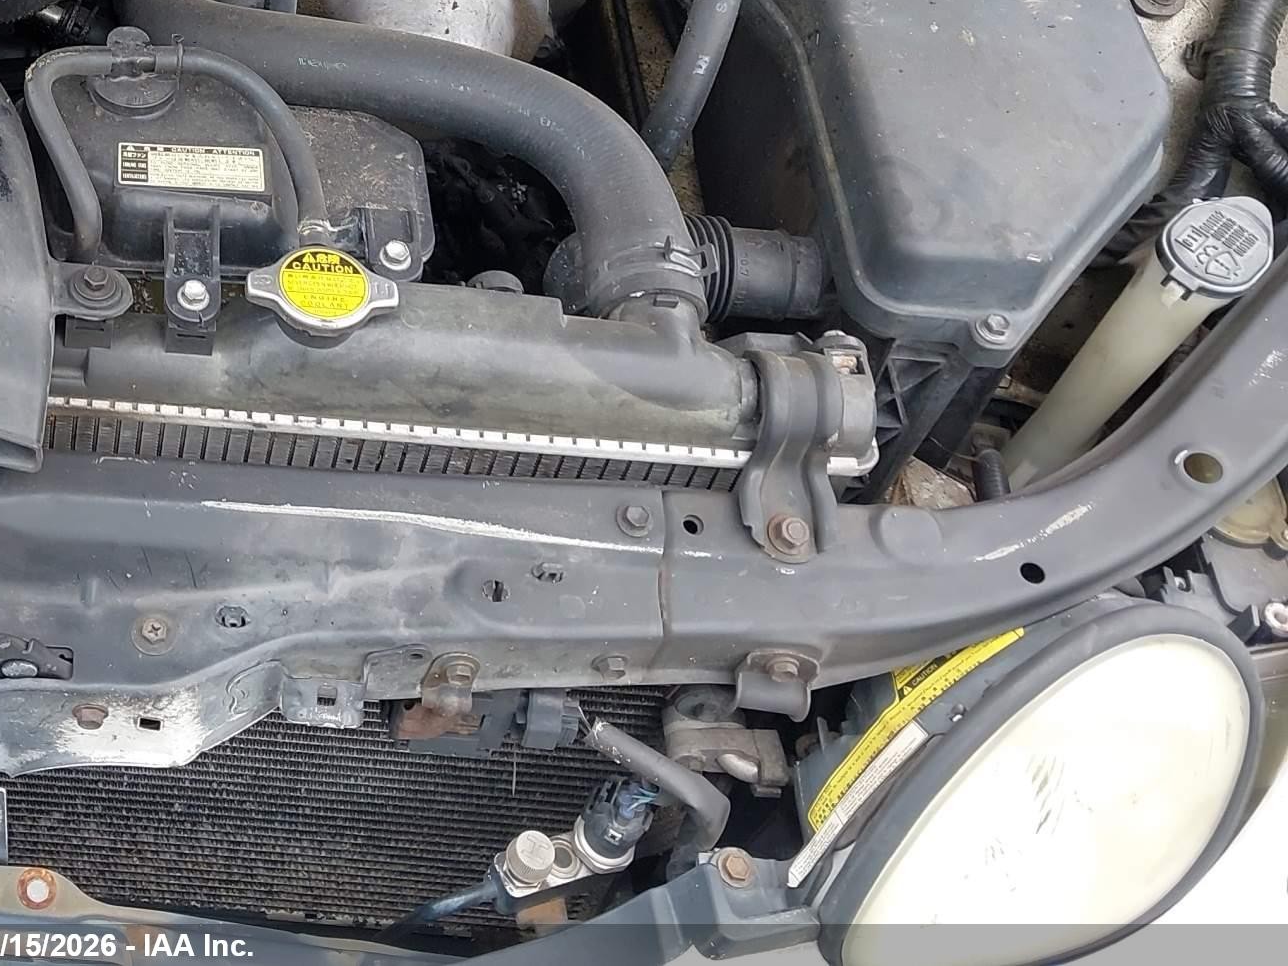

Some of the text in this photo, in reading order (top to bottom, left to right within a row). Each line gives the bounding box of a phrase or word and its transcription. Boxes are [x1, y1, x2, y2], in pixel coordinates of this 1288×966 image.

[292, 262, 353, 274] CAUTION
[303, 294, 345, 303] ENGINE
[300, 300, 349, 310] COOLANT
[912, 663, 939, 686] CAUTION
